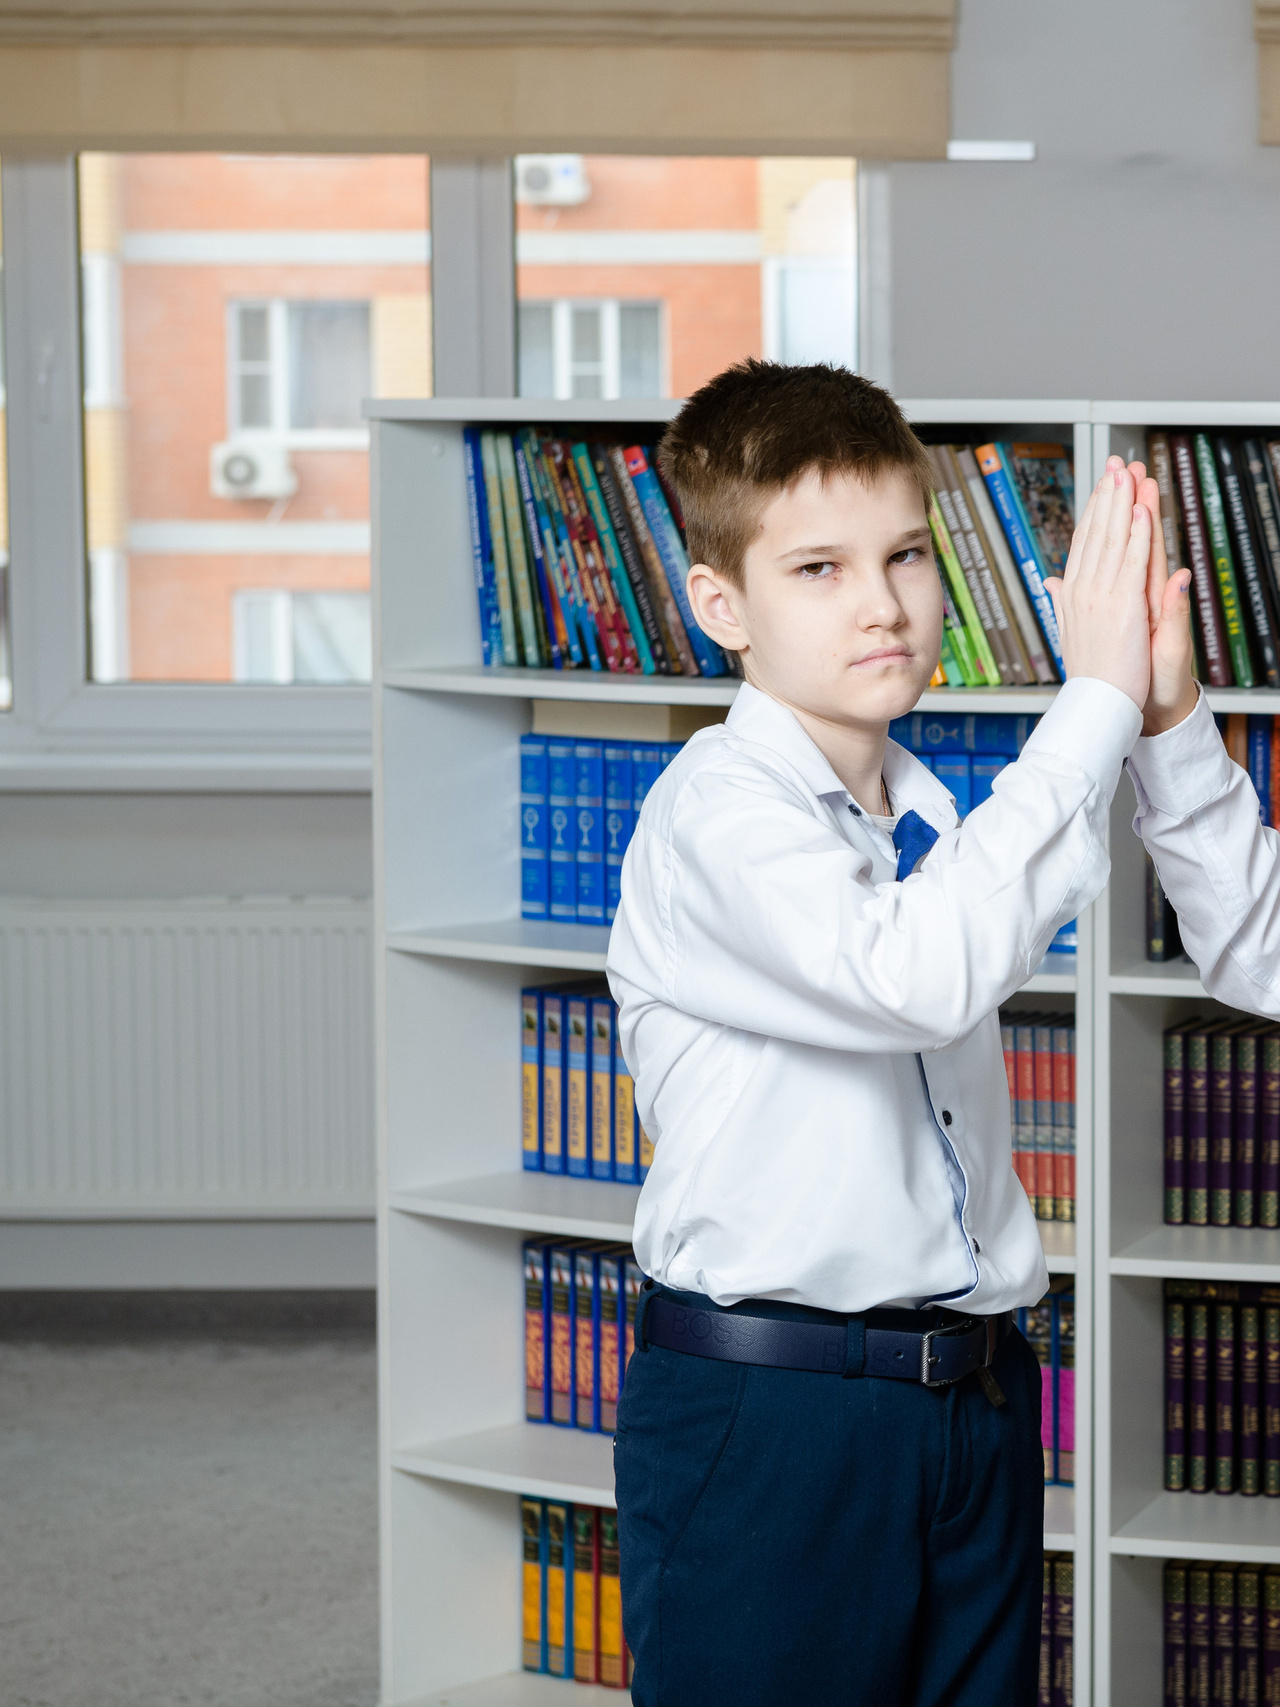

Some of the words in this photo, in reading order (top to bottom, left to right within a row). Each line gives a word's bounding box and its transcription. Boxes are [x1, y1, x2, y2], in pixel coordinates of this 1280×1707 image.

[1175, 445, 1196, 509] ЛЕГЕНДЫ
[1186, 511, 1198, 522] И
[1187, 524, 1210, 599] ПРЕДАНИЯ
[1236, 531, 1256, 576] ИМЕНА
[1246, 577, 1269, 636] РОССИИ
[1215, 556, 1241, 635] СКАЗКИ
[1199, 600, 1219, 659] ЕВРОПЫ
[671, 1308, 755, 1348] BOSS
[821, 1340, 910, 1374] BSS
